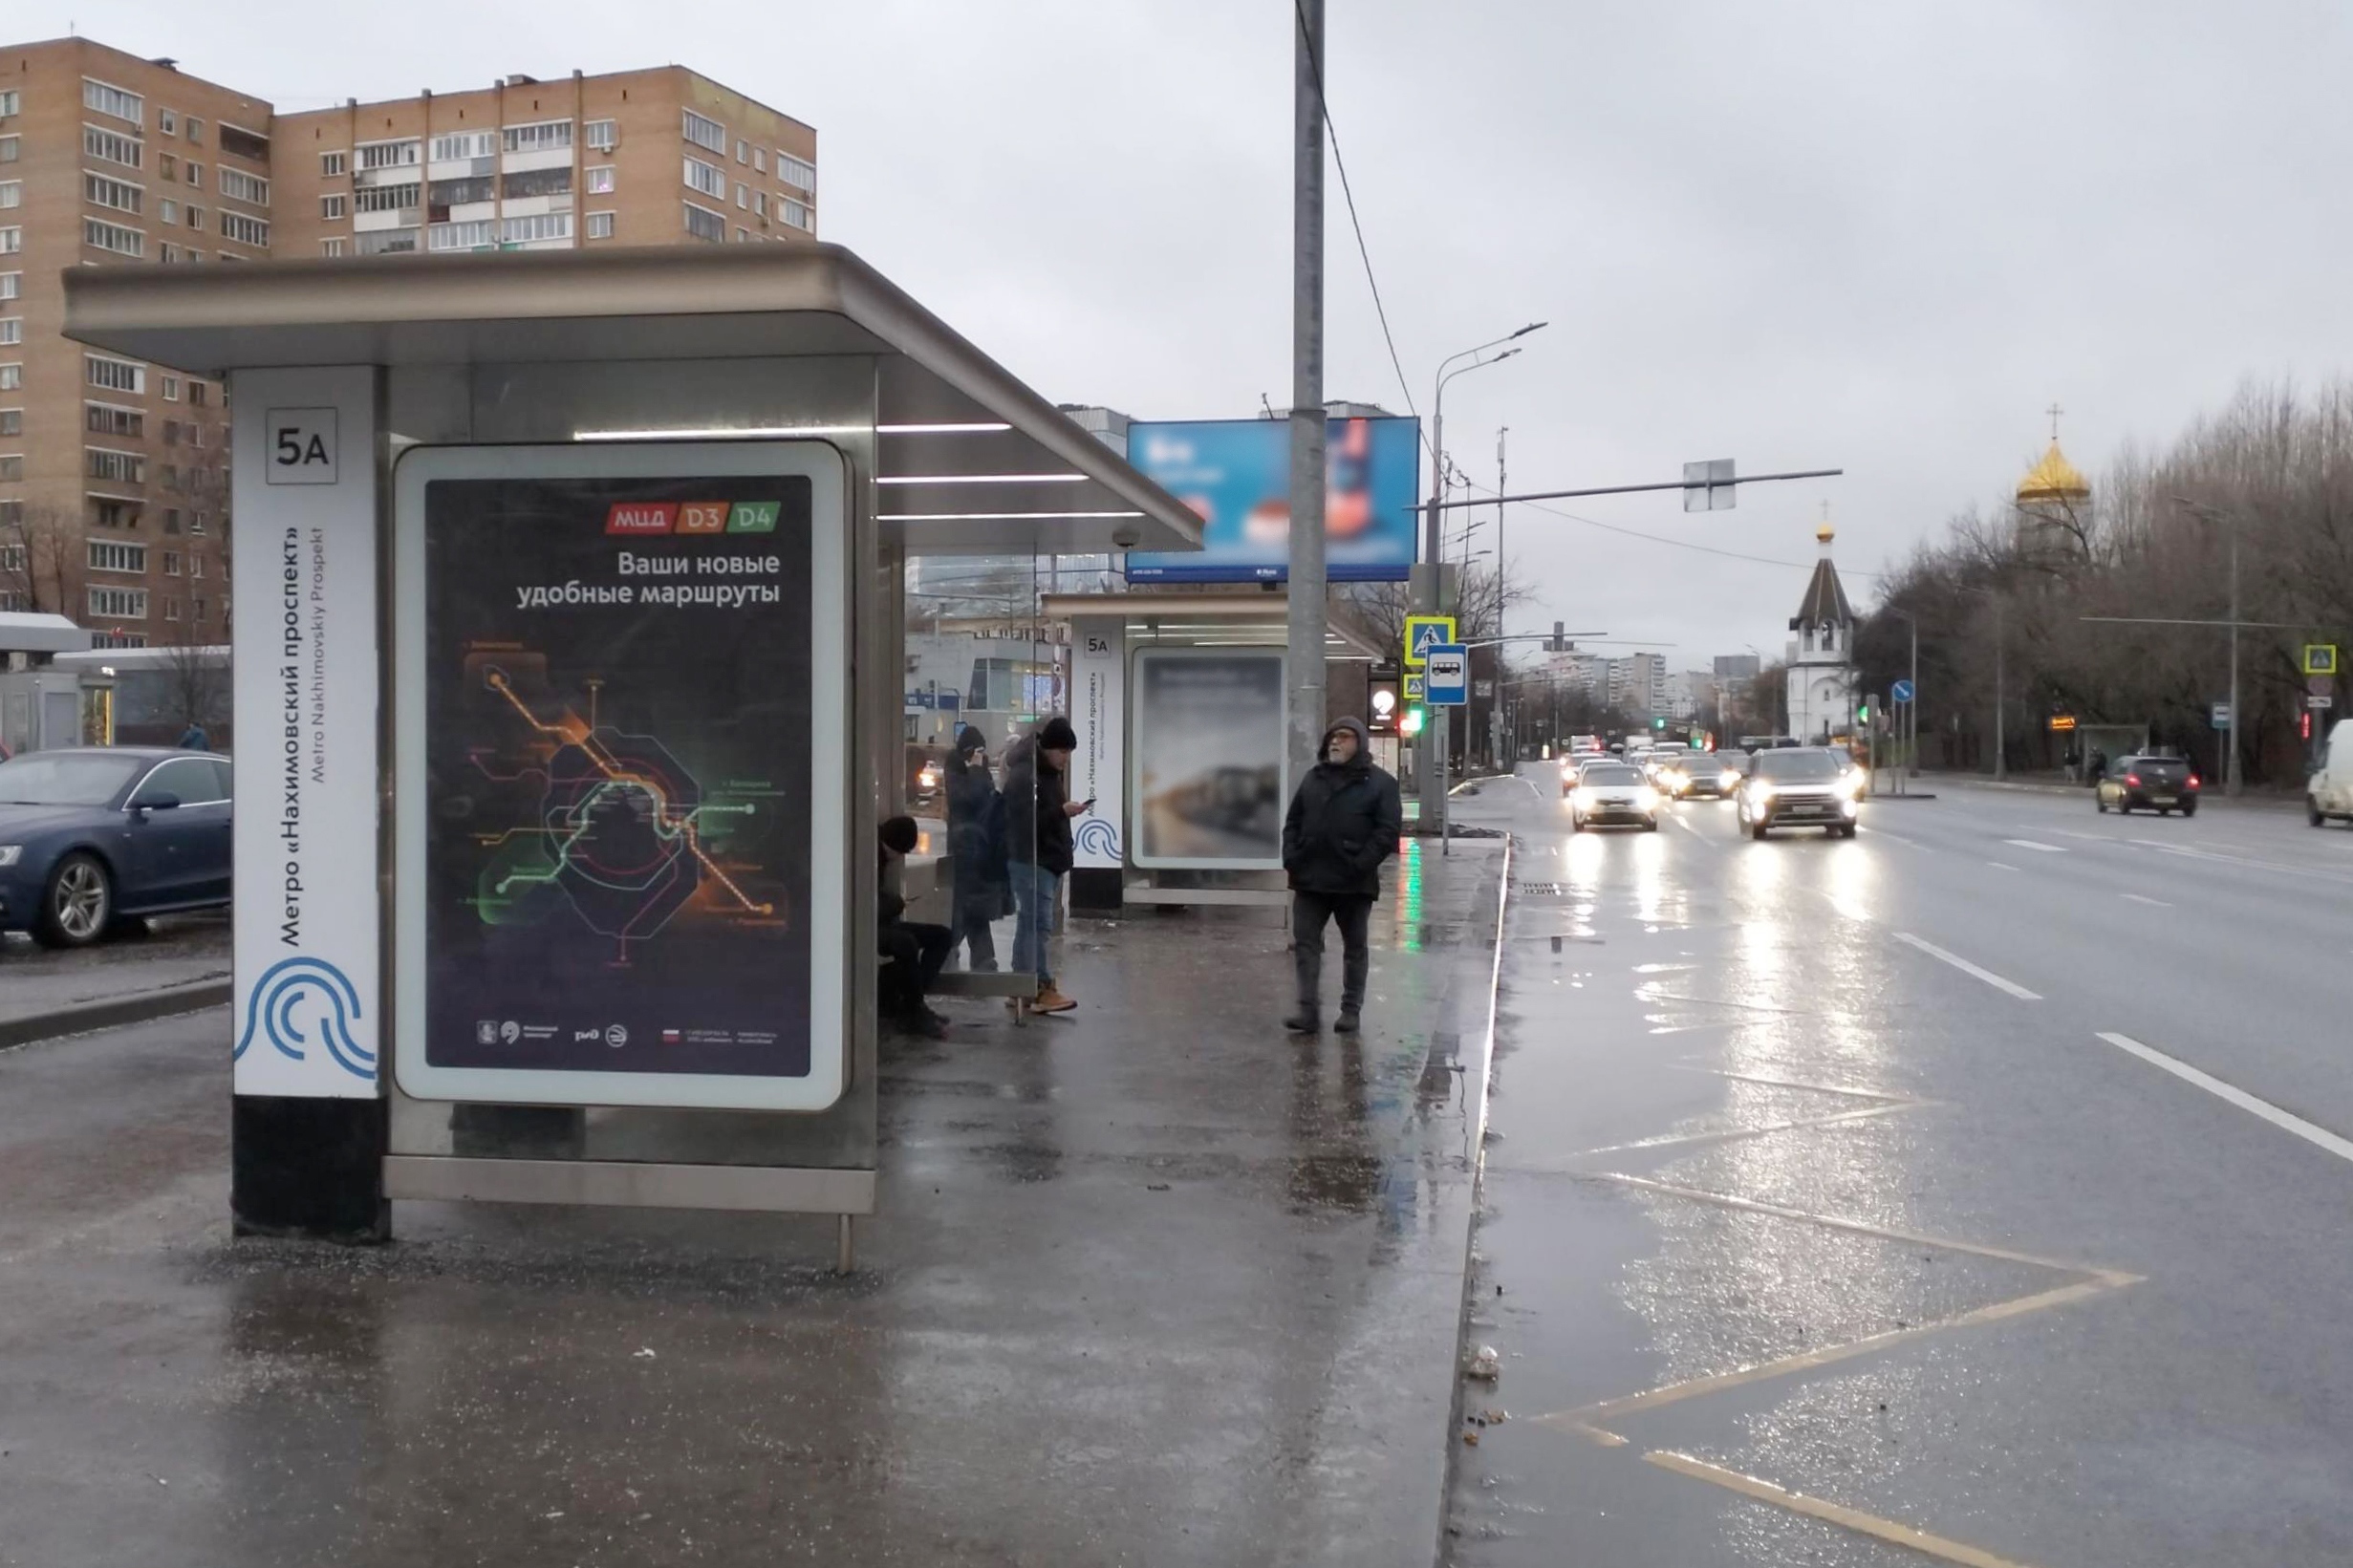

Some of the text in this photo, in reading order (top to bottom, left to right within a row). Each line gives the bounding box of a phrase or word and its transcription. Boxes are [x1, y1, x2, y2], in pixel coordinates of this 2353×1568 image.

[615, 507, 771, 528] МЦД D3 D4
[618, 551, 781, 575] Ваши новые
[516, 579, 780, 610] удобные маршруты
[309, 526, 327, 784] Metro Nakhimovskiy Prospekt
[280, 527, 304, 947] Метро «Нахимовский проспект»
